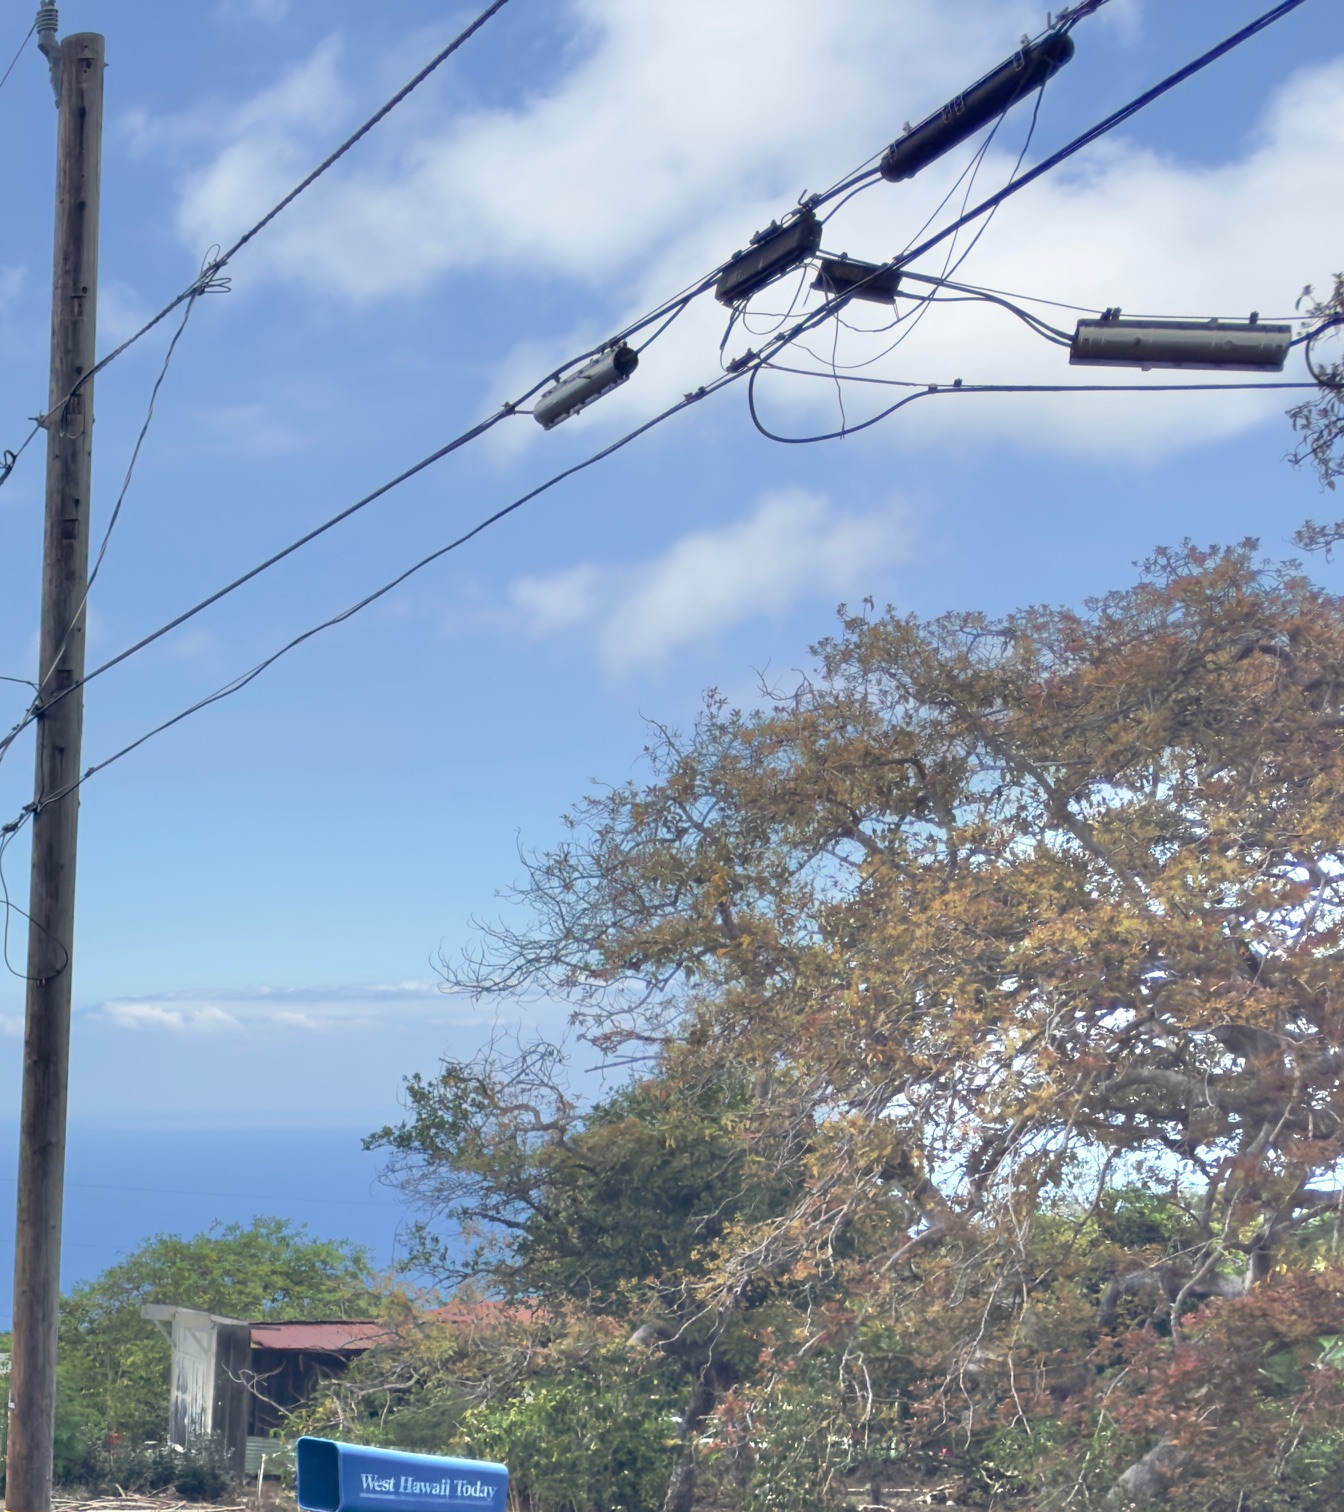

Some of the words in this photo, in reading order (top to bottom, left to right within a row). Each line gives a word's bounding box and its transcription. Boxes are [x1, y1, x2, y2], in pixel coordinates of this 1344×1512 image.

[360, 1473, 395, 1492] West
[398, 1476, 450, 1497] Hawaii
[454, 1479, 497, 1502] Today
